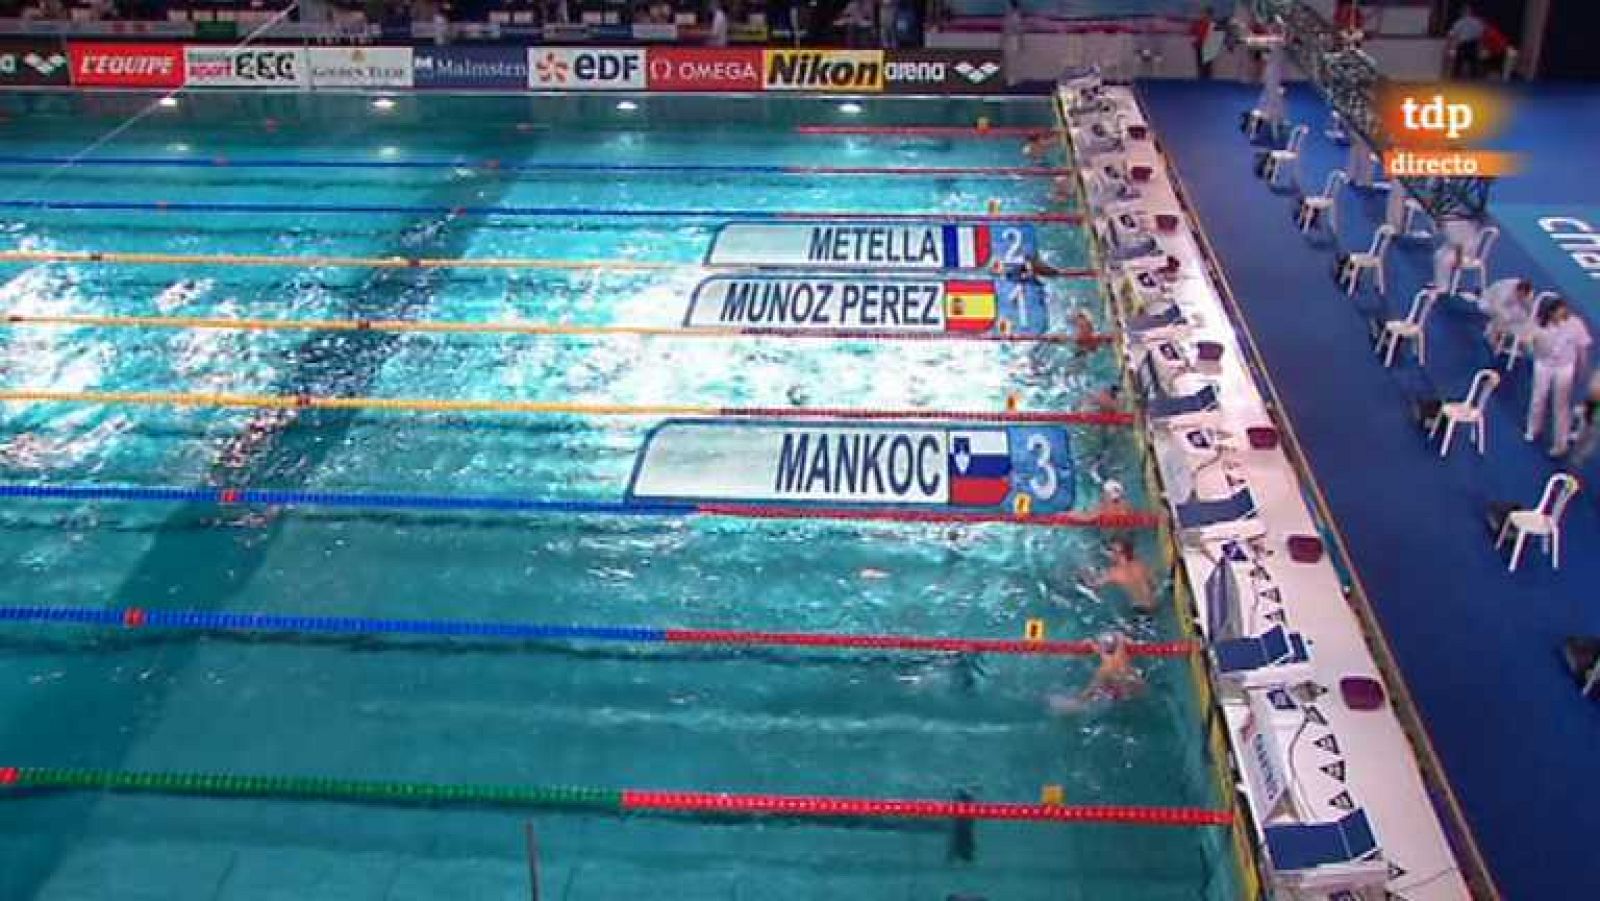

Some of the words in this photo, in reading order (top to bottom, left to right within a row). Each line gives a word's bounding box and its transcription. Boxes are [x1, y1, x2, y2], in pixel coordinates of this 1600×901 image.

[679, 62, 758, 81] OMEGA
[765, 54, 879, 87] Nikon
[884, 62, 946, 82] arena
